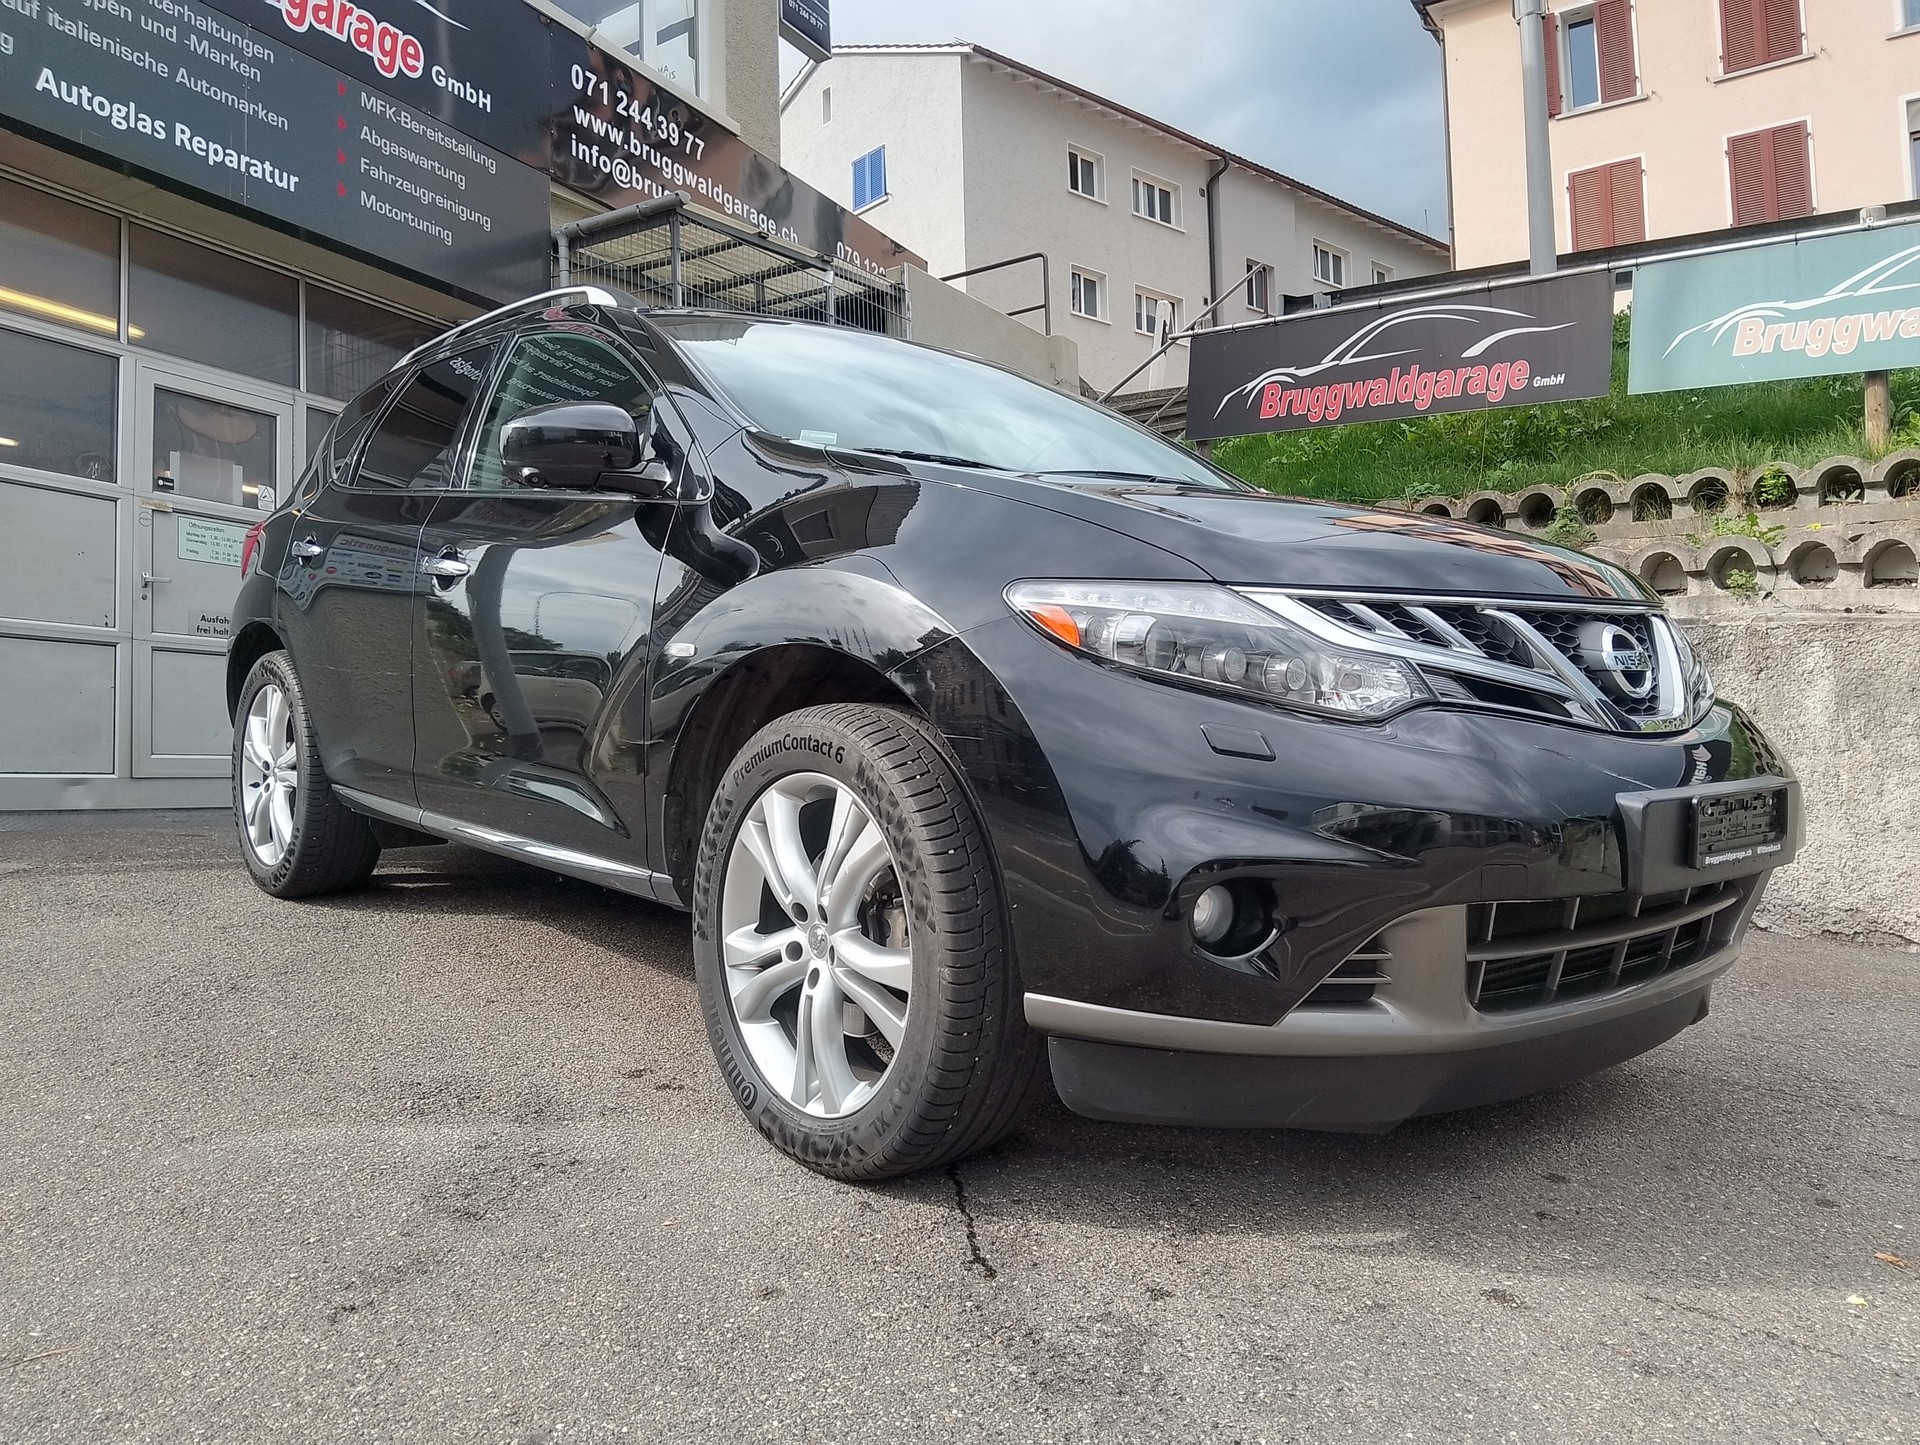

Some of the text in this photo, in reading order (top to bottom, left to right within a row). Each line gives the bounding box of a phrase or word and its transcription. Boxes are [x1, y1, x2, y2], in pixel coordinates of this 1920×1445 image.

[47, 7, 169, 78] italienische
[175, 67, 289, 131] Automarken
[140, 14, 177, 43] und
[184, 34, 261, 82] -Marken
[262, 0, 492, 113] garage GmbH
[35, 66, 300, 193] Autoglas Reparatur
[360, 91, 497, 174] MFK-Bereitstellung
[570, 63, 705, 161] 071 244 39 77
[360, 125, 466, 190] Abgaswartung
[573, 104, 799, 245] www.bruggwaldgarage.ch
[360, 157, 491, 232] Fahrzeugreinigung
[360, 190, 453, 246] Motortuning
[837, 241, 860, 267] 079
[1259, 359, 1566, 424] Bruggwaldgarage GmbH
[196, 625, 211, 634] frei
[733, 733, 845, 787] PremiumContact 6
